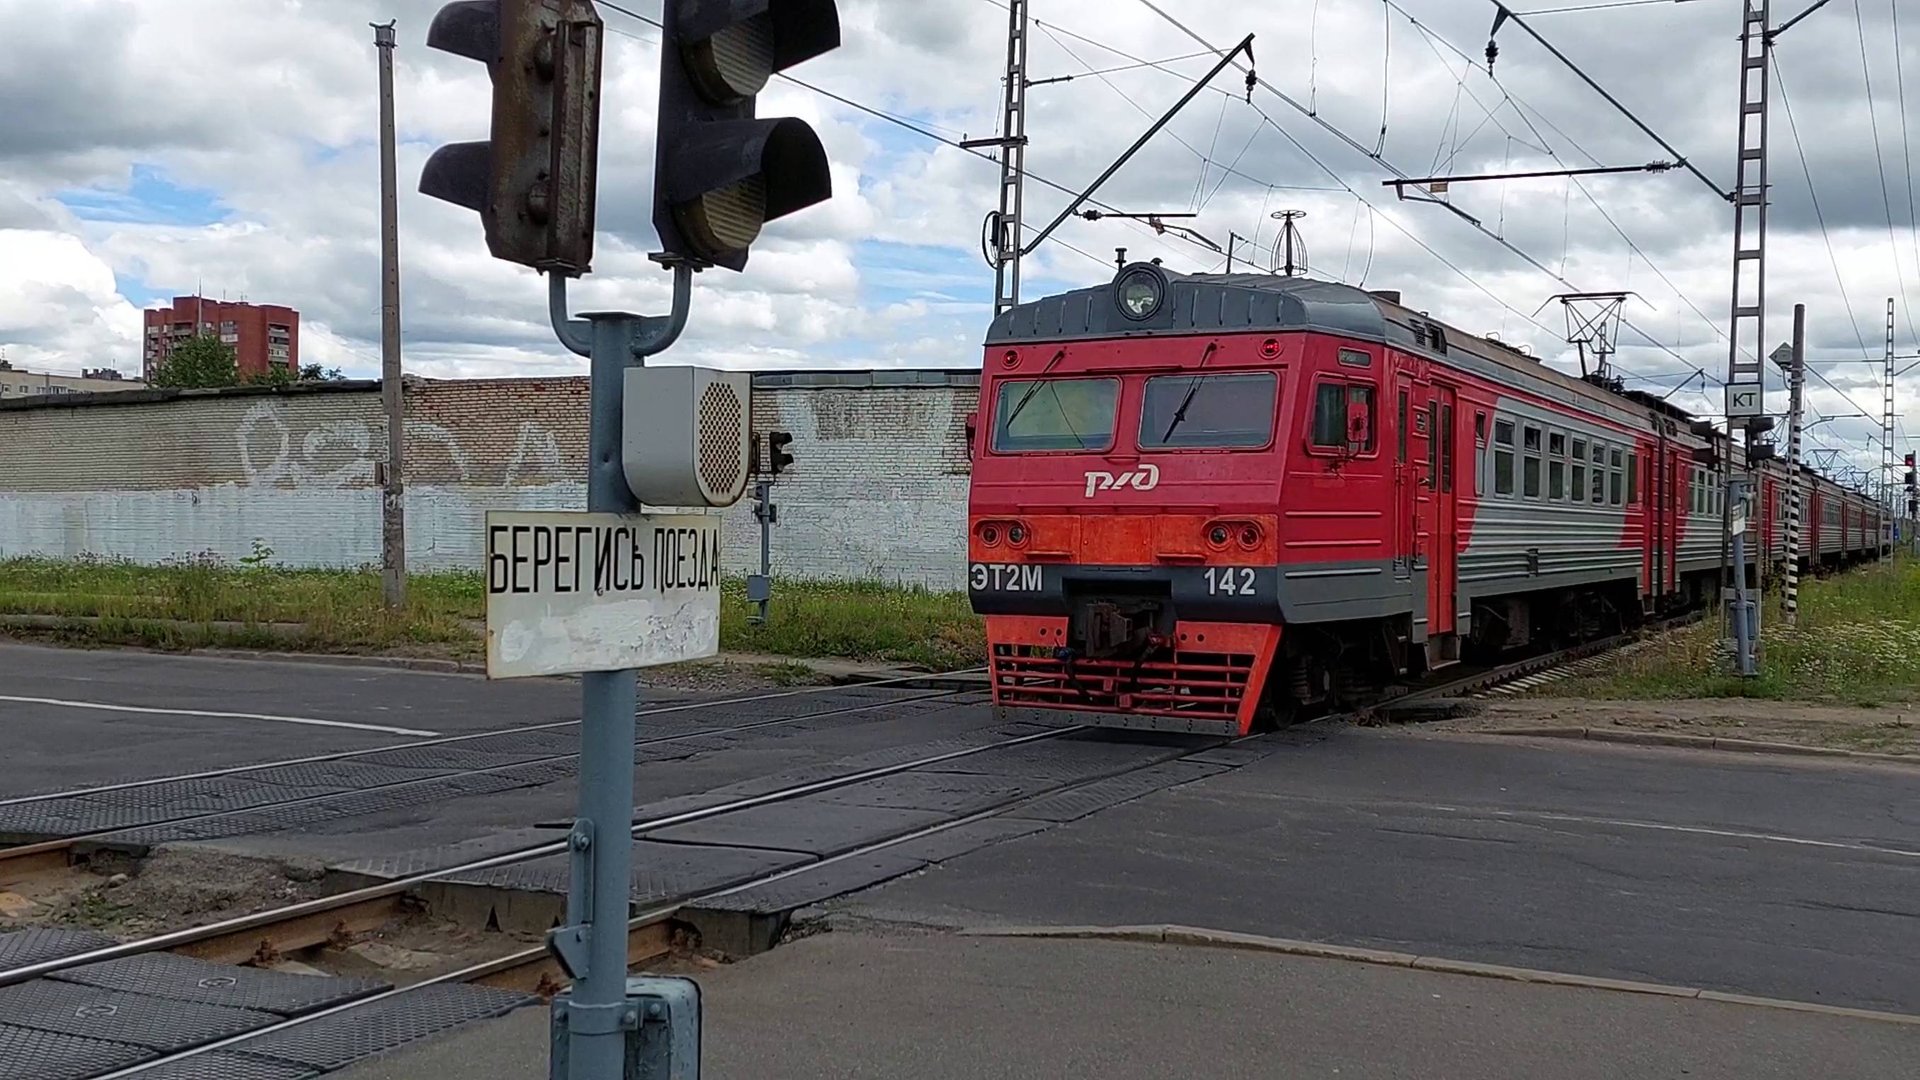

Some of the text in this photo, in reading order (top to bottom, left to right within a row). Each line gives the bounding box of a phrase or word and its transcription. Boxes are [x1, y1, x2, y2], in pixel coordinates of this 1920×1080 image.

[1733, 392, 1757, 407] КТ
[489, 525, 720, 594] БЕРЕГИСЬ ПОЕЗДА
[970, 563, 1044, 592] ЭТ2М
[1203, 567, 1256, 596] 142
